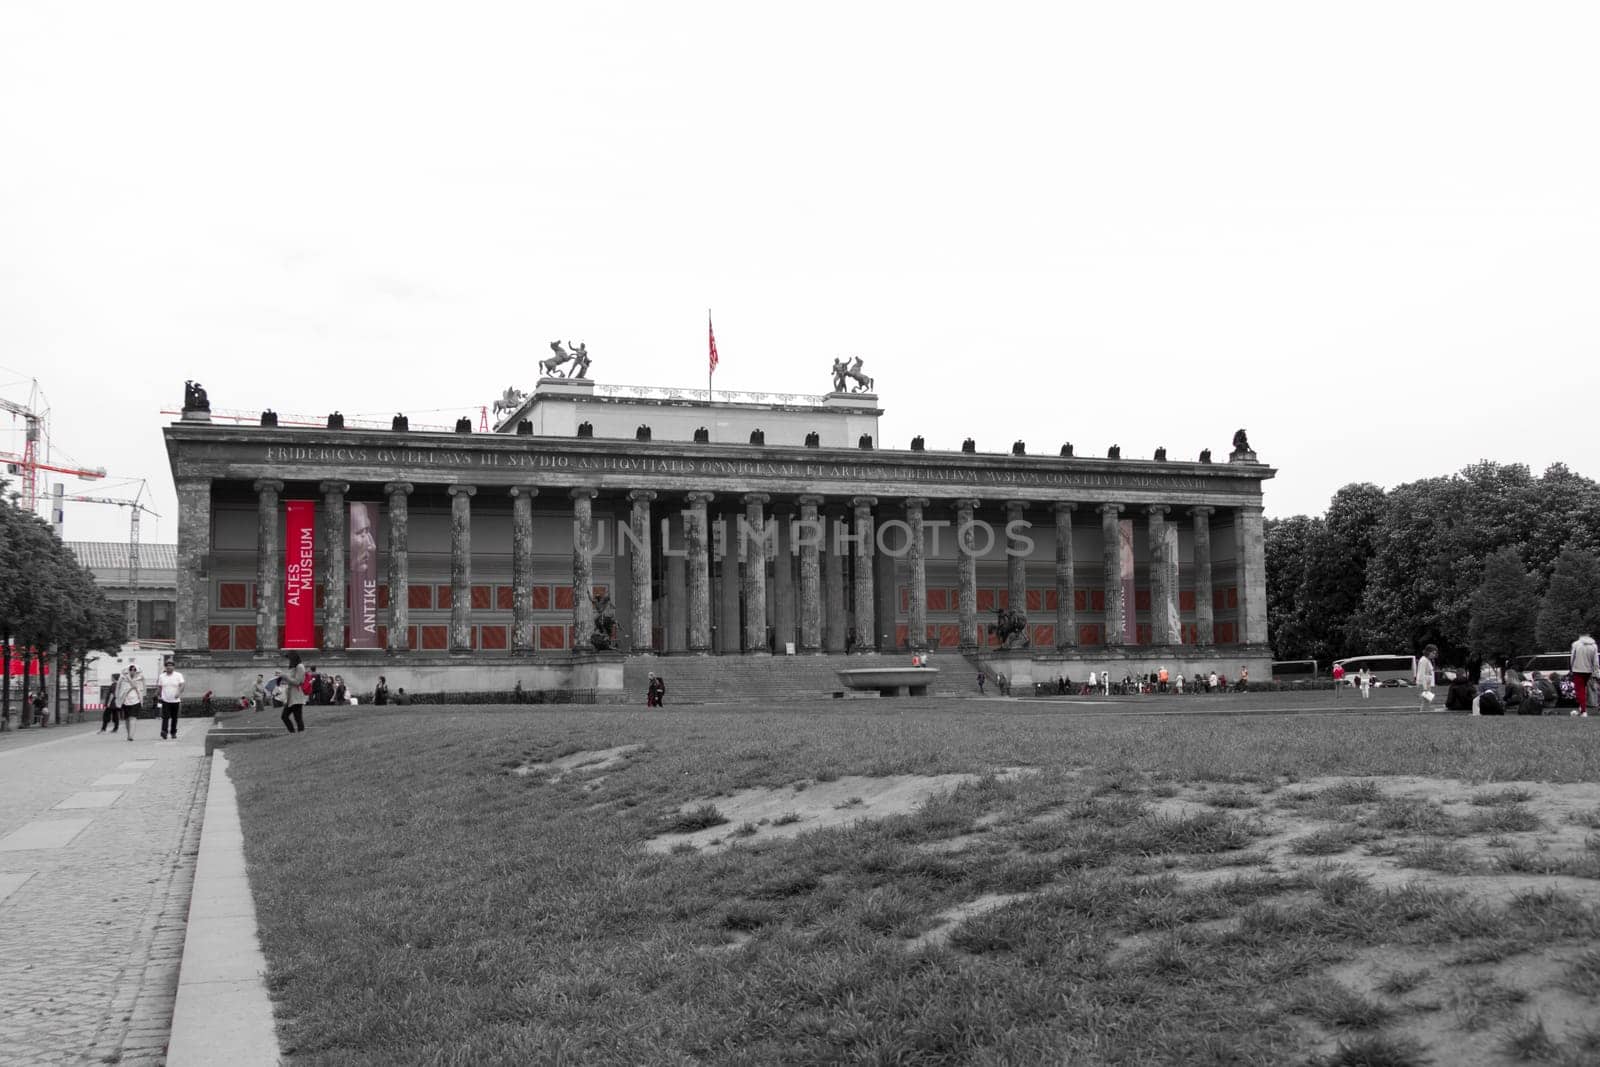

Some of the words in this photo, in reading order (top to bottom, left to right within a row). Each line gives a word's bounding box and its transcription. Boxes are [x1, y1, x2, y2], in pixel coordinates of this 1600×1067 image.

[267, 447, 367, 461] FRIDERICVS
[481, 453, 498, 465] III
[507, 454, 569, 467] STVDIO
[300, 528, 313, 590] MUSEUM
[287, 564, 300, 606] ALTES
[364, 579, 376, 633] ANTIKE
